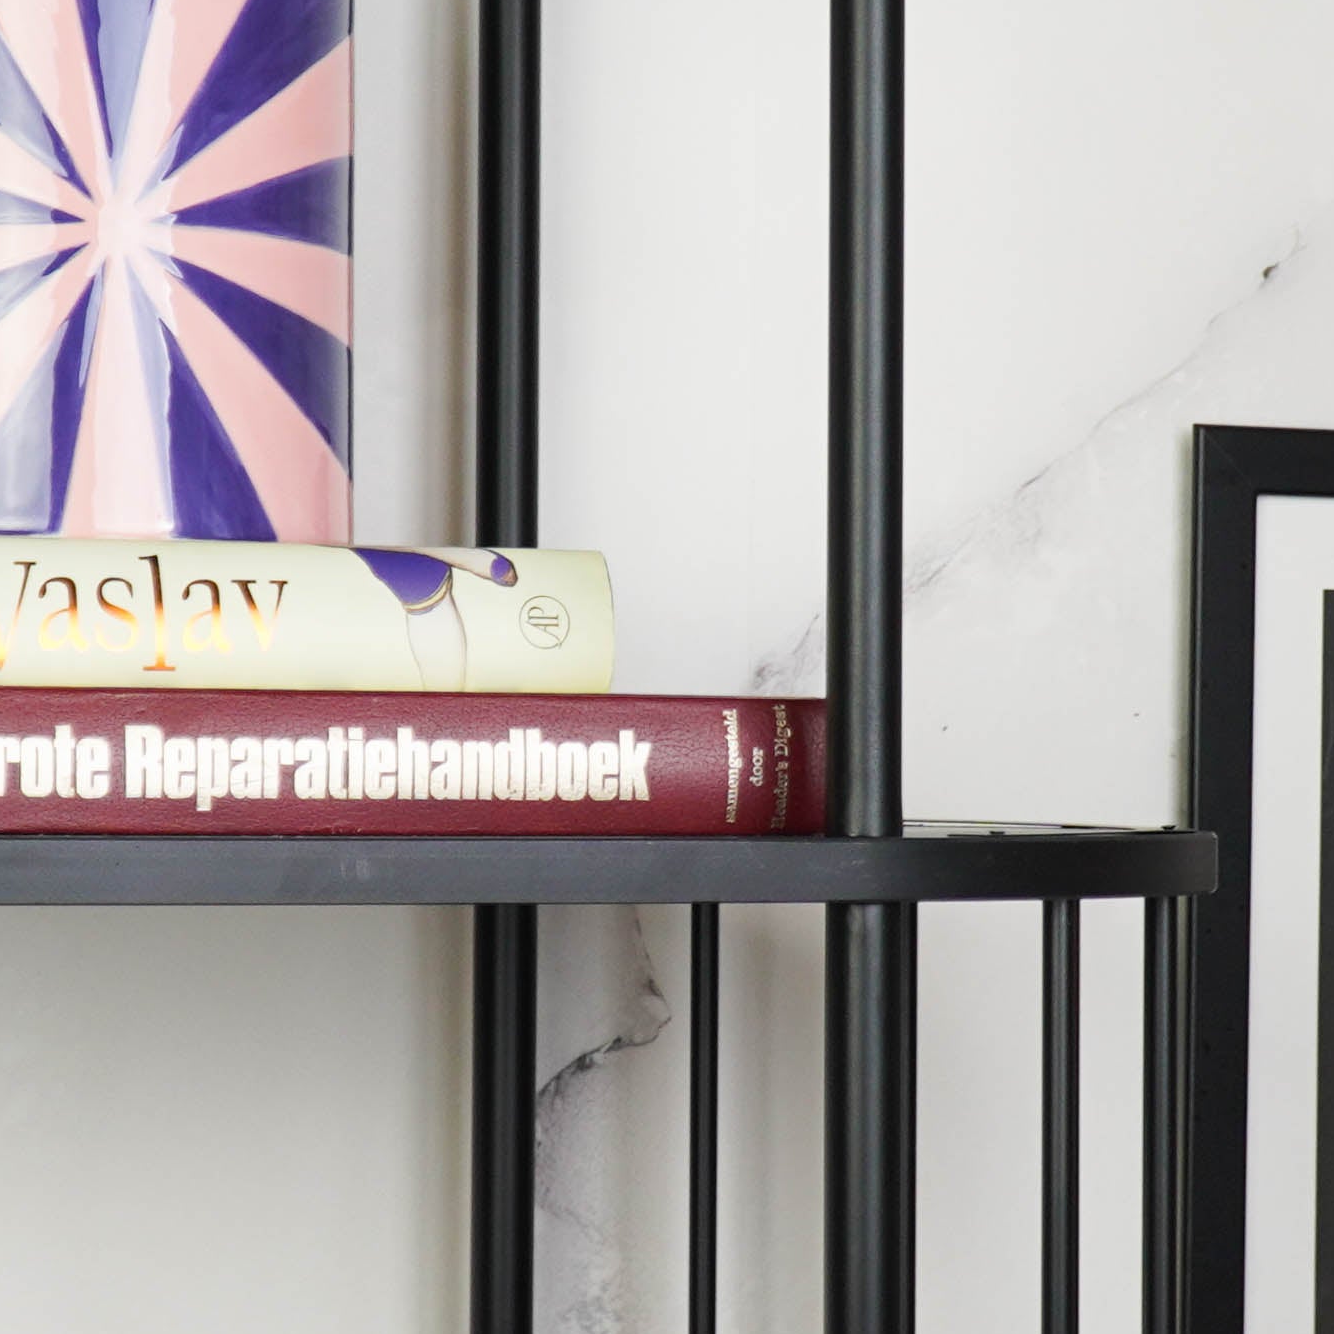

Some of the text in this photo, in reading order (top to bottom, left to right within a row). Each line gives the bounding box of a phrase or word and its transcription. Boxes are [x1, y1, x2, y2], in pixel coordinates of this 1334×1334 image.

[722, 708, 742, 823] samengesteld
[773, 704, 792, 757] Digest
[124, 724, 653, 811] Reparatiehandboek
[749, 747, 764, 787] door
